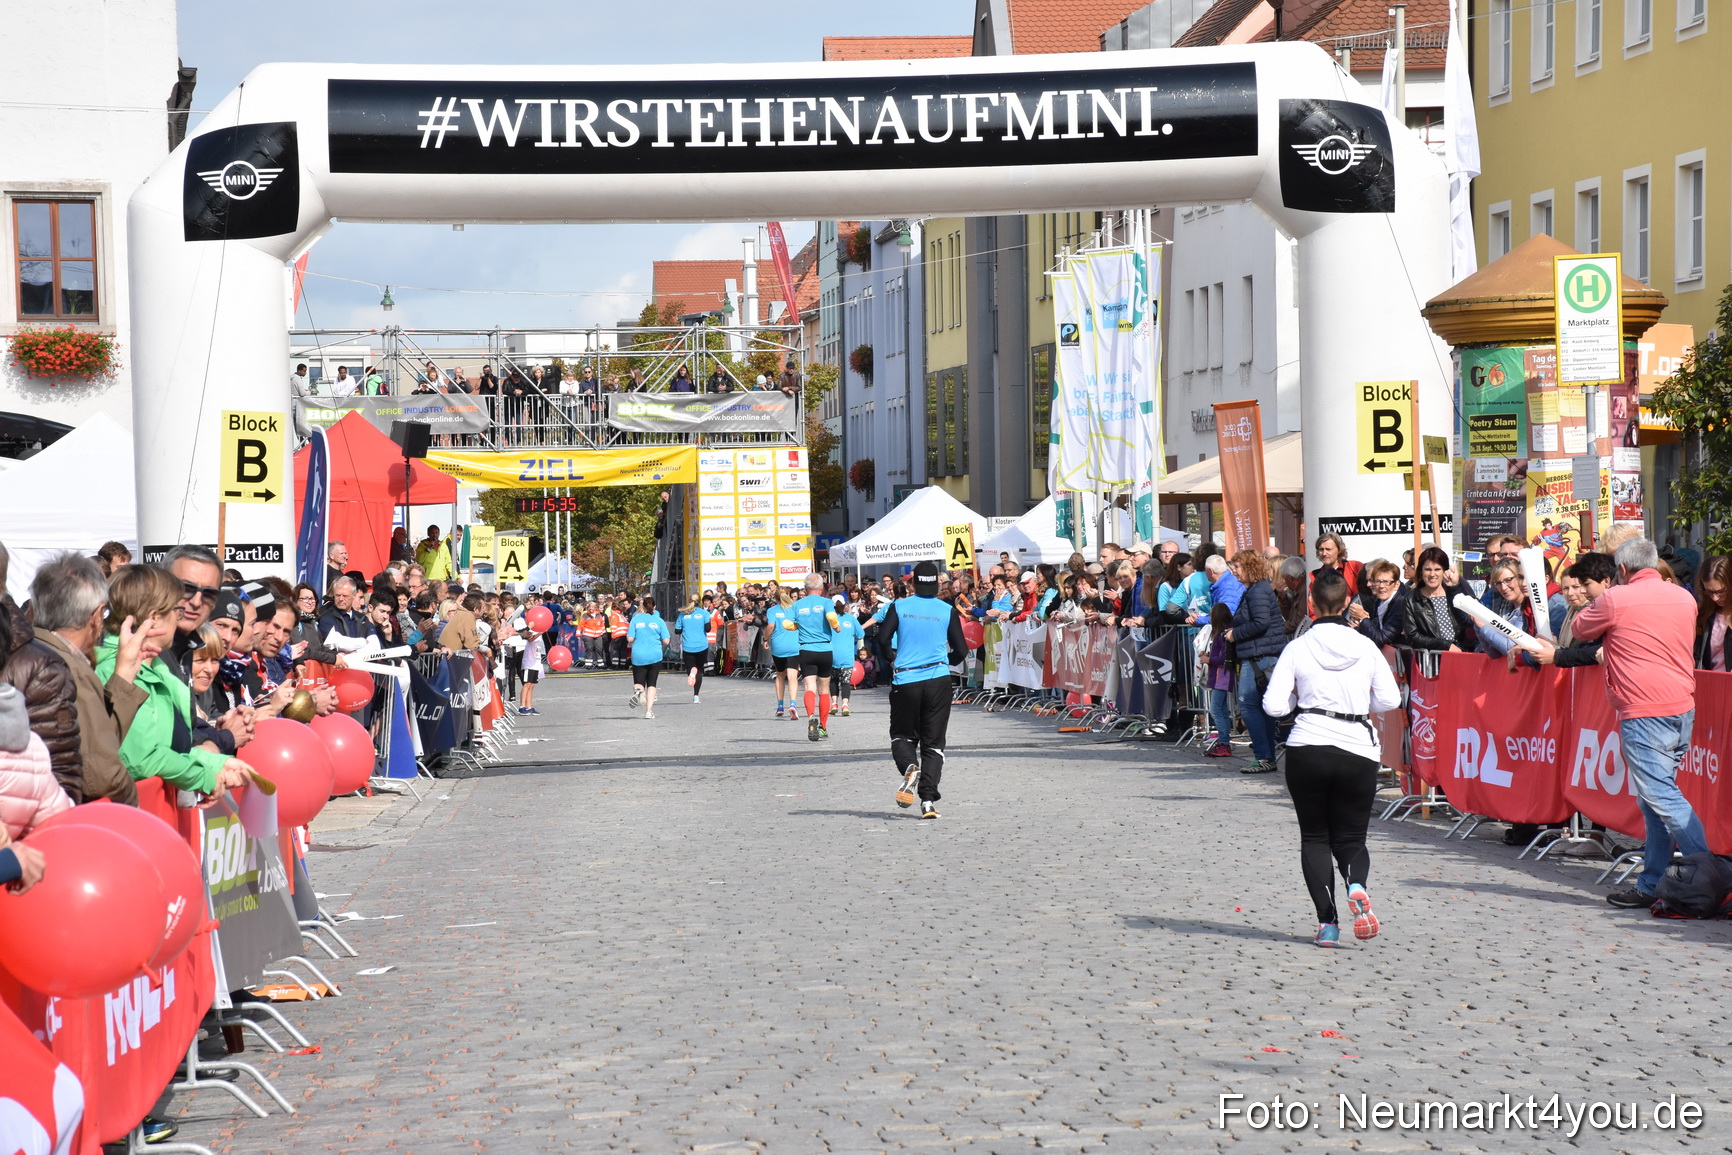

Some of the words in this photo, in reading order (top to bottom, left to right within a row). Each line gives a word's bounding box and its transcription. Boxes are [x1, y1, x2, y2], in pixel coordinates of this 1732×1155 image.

[417, 86, 1173, 149] #WIRSTEHENAUFMINI.
[1320, 149, 1352, 162] MINI
[225, 174, 255, 186] MINI
[1576, 274, 1599, 303] H
[1568, 319, 1610, 327] Marktplatz
[1532, 355, 1546, 364] Tag
[1363, 385, 1411, 401] Block
[376, 408, 402, 416] OFFICE
[618, 403, 674, 415] BOCK
[229, 414, 278, 432] Block
[1470, 420, 1492, 428] Poetry
[1373, 409, 1404, 453] B
[236, 439, 268, 483] B
[519, 459, 584, 480] ZIEL
[1466, 490, 1520, 499] Erntedankfest
[946, 525, 970, 535] Block
[1322, 517, 1453, 533] www.MINI-Par.de
[501, 538, 525, 547] Block
[865, 544, 888, 552] BMW
[952, 537, 969, 560] A
[504, 550, 521, 572] A
[1531, 583, 1541, 603] swn
[1490, 620, 1512, 635] swn
[244, 894, 259, 911] con
